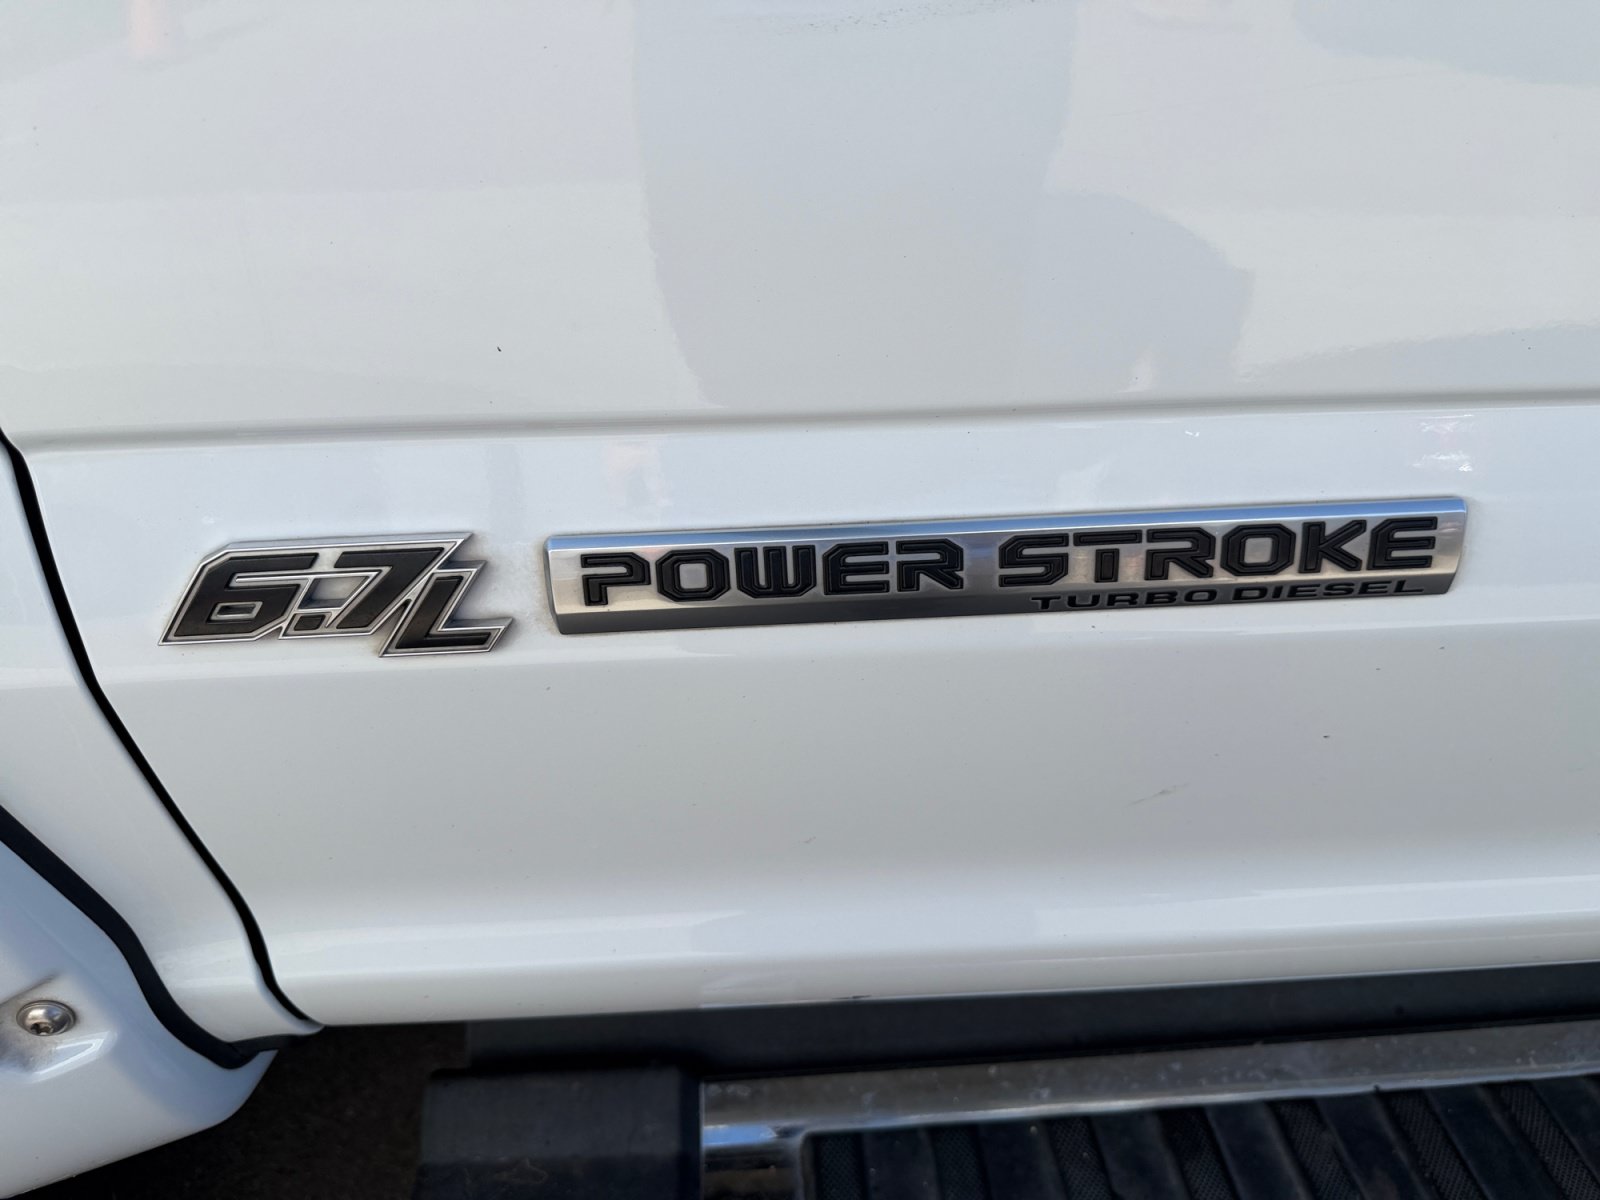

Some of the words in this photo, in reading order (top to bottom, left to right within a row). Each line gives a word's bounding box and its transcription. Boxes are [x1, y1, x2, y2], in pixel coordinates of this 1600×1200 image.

[166, 541, 500, 653] 6.7L
[580, 538, 964, 606] POWER
[998, 517, 1438, 587] STROKE
[1031, 588, 1217, 610] TURBO
[1232, 580, 1424, 601] DIESEL
